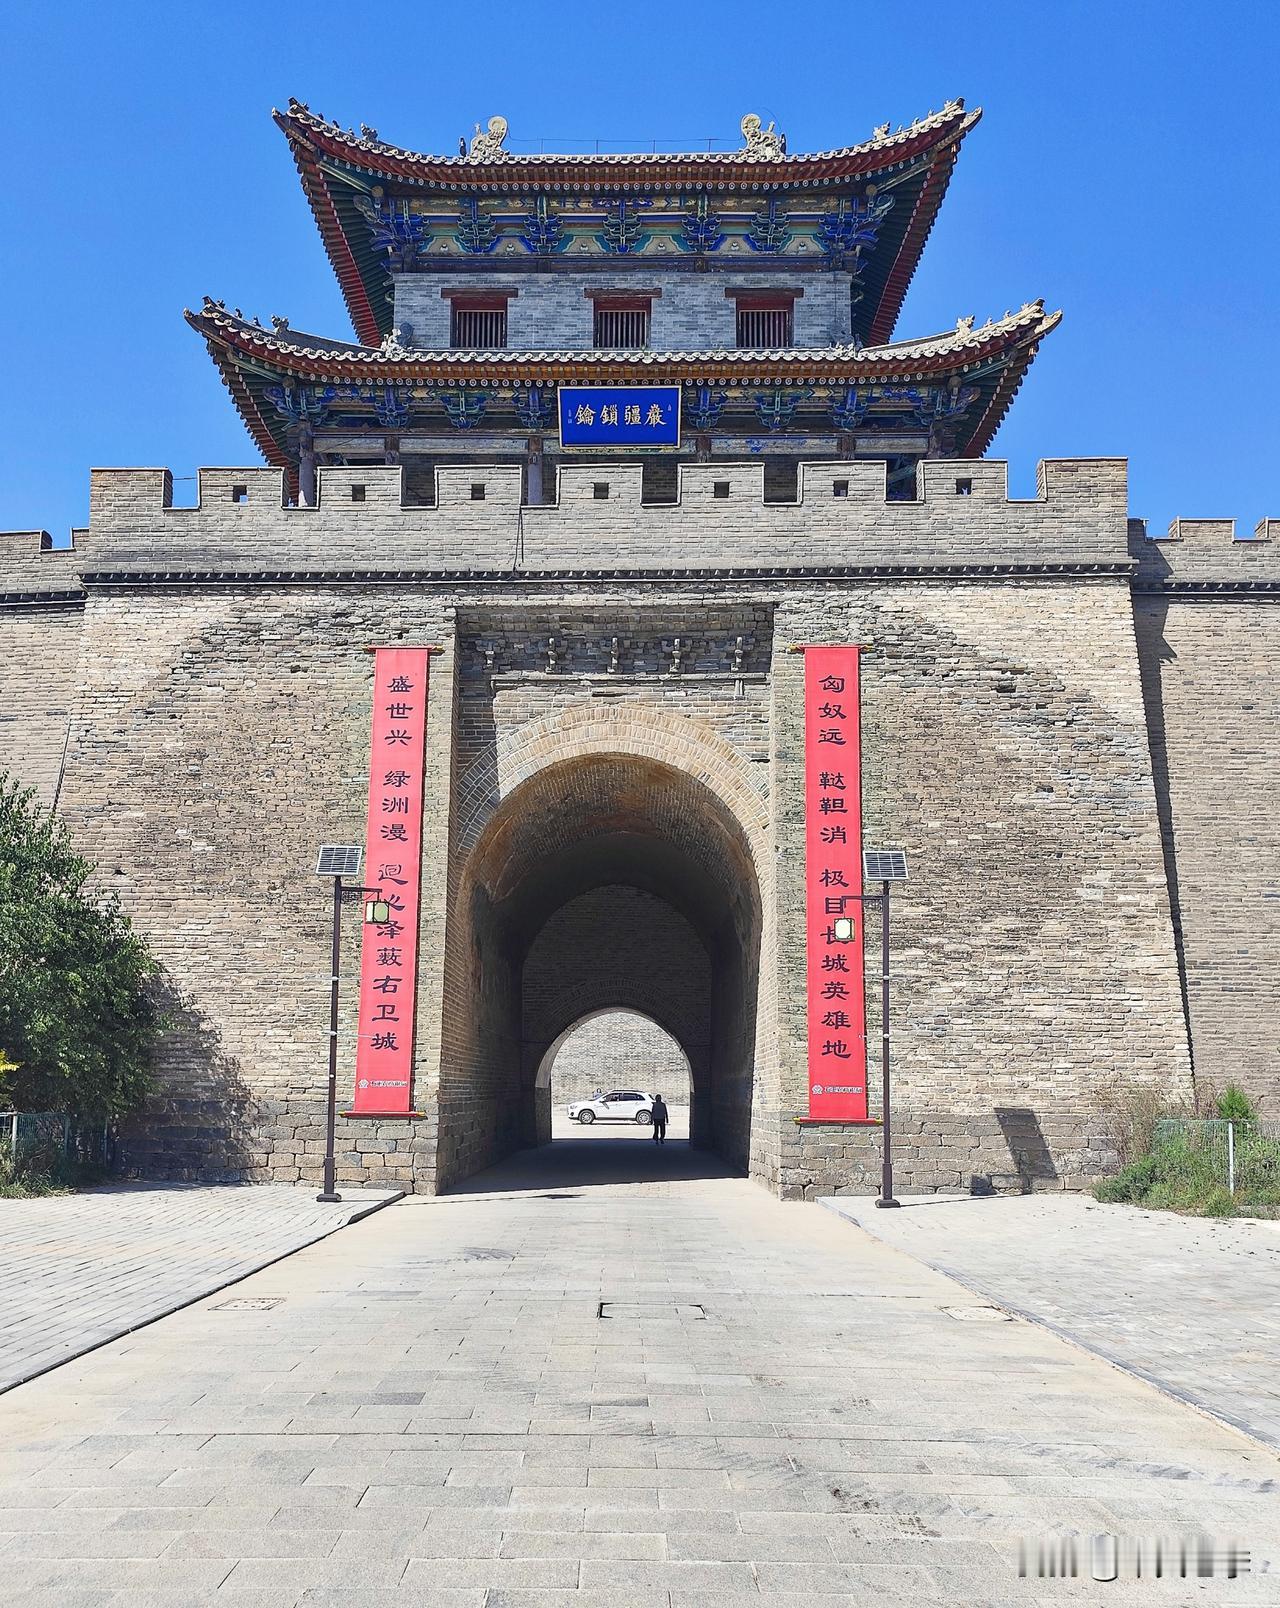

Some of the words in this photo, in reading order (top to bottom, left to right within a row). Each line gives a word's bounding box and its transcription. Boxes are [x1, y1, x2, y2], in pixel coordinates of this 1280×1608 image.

[384, 676, 414, 746] 盛世兴
[818, 675, 847, 746] 匈奴远
[380, 770, 411, 841] 绿洲漫
[818, 771, 849, 844] 鞑靼消
